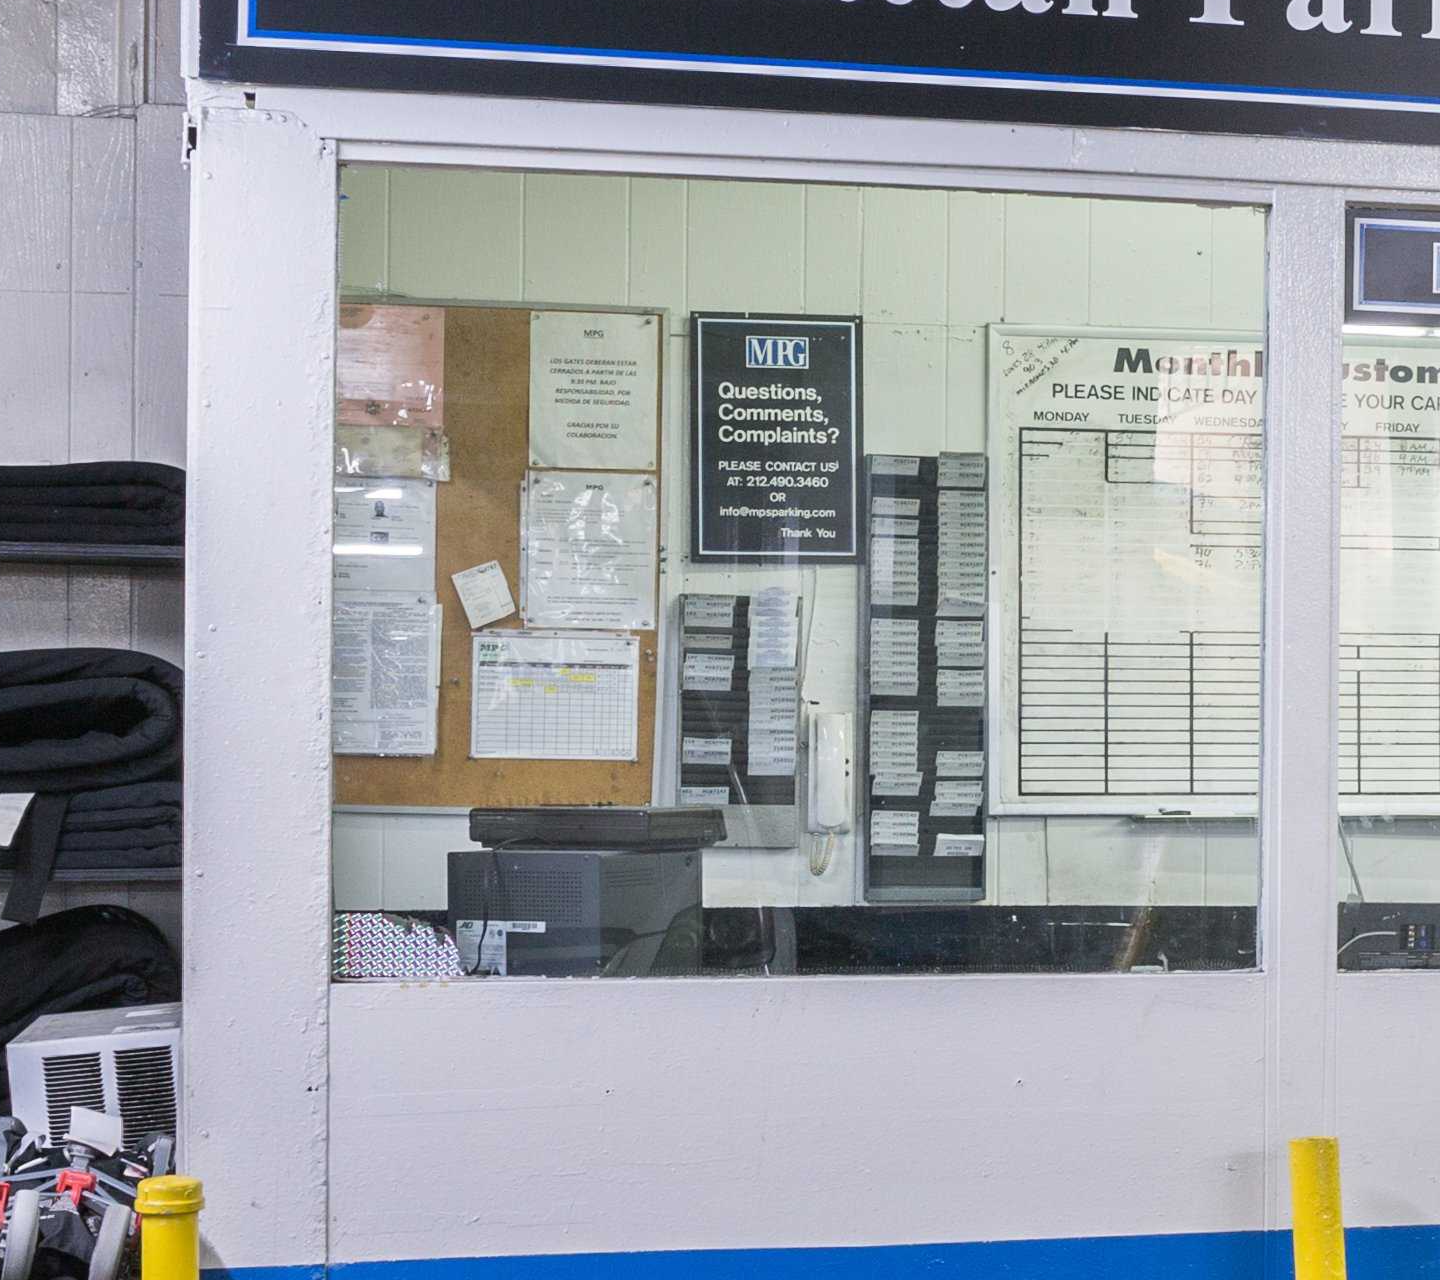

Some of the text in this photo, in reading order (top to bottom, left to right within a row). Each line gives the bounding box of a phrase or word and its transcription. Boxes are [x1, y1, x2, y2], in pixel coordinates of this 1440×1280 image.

[584, 330, 604, 338] MPG
[750, 338, 807, 367] MPG
[1113, 347, 1263, 378] Monthl
[718, 381, 822, 403] Questions,
[1052, 383, 1257, 405] PLEASE INDICATE DAY
[1354, 394, 1405, 410] YOUR
[718, 403, 829, 424] Comments,
[1033, 410, 1090, 422] MONDAY
[1118, 413, 1178, 426] TUESDAY
[1193, 416, 1263, 428] WEDNESDA
[1376, 422, 1420, 433] FRIDAY
[718, 425, 840, 446] Complaints?
[718, 461, 761, 471] PLEASE
[765, 461, 816, 472] CONTACT
[726, 476, 829, 488] AT: 212.490.3460
[770, 493, 786, 502] OR
[720, 506, 836, 519] info@mpsparking.com
[781, 527, 836, 538] Thank You
